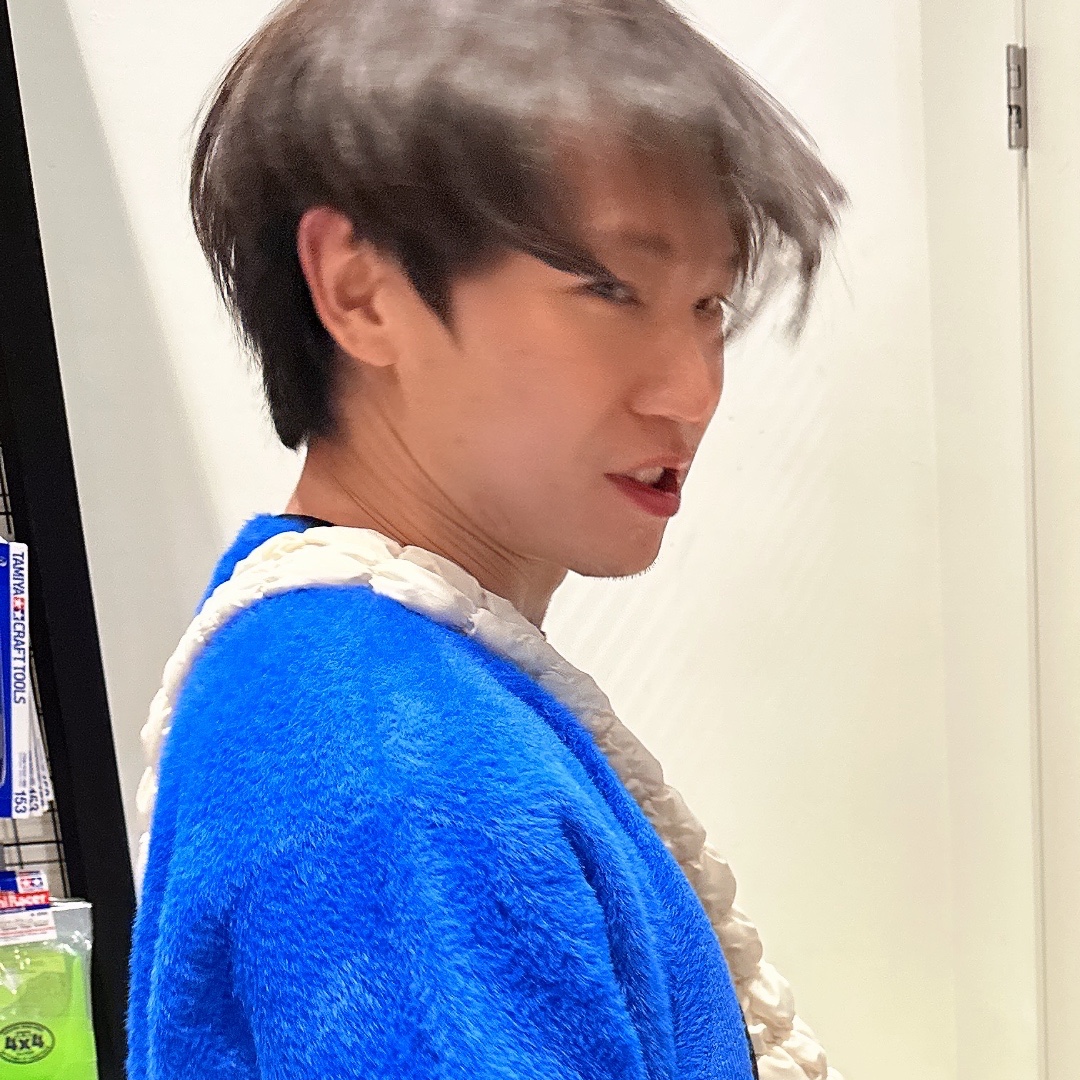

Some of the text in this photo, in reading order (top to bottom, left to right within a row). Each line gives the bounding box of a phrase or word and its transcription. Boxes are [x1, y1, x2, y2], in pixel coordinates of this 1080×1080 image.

[12, 552, 26, 704] TAMIYA CRAFT TOOLS
[14, 790, 26, 813] 153
[5, 1034, 44, 1050] 4x4
